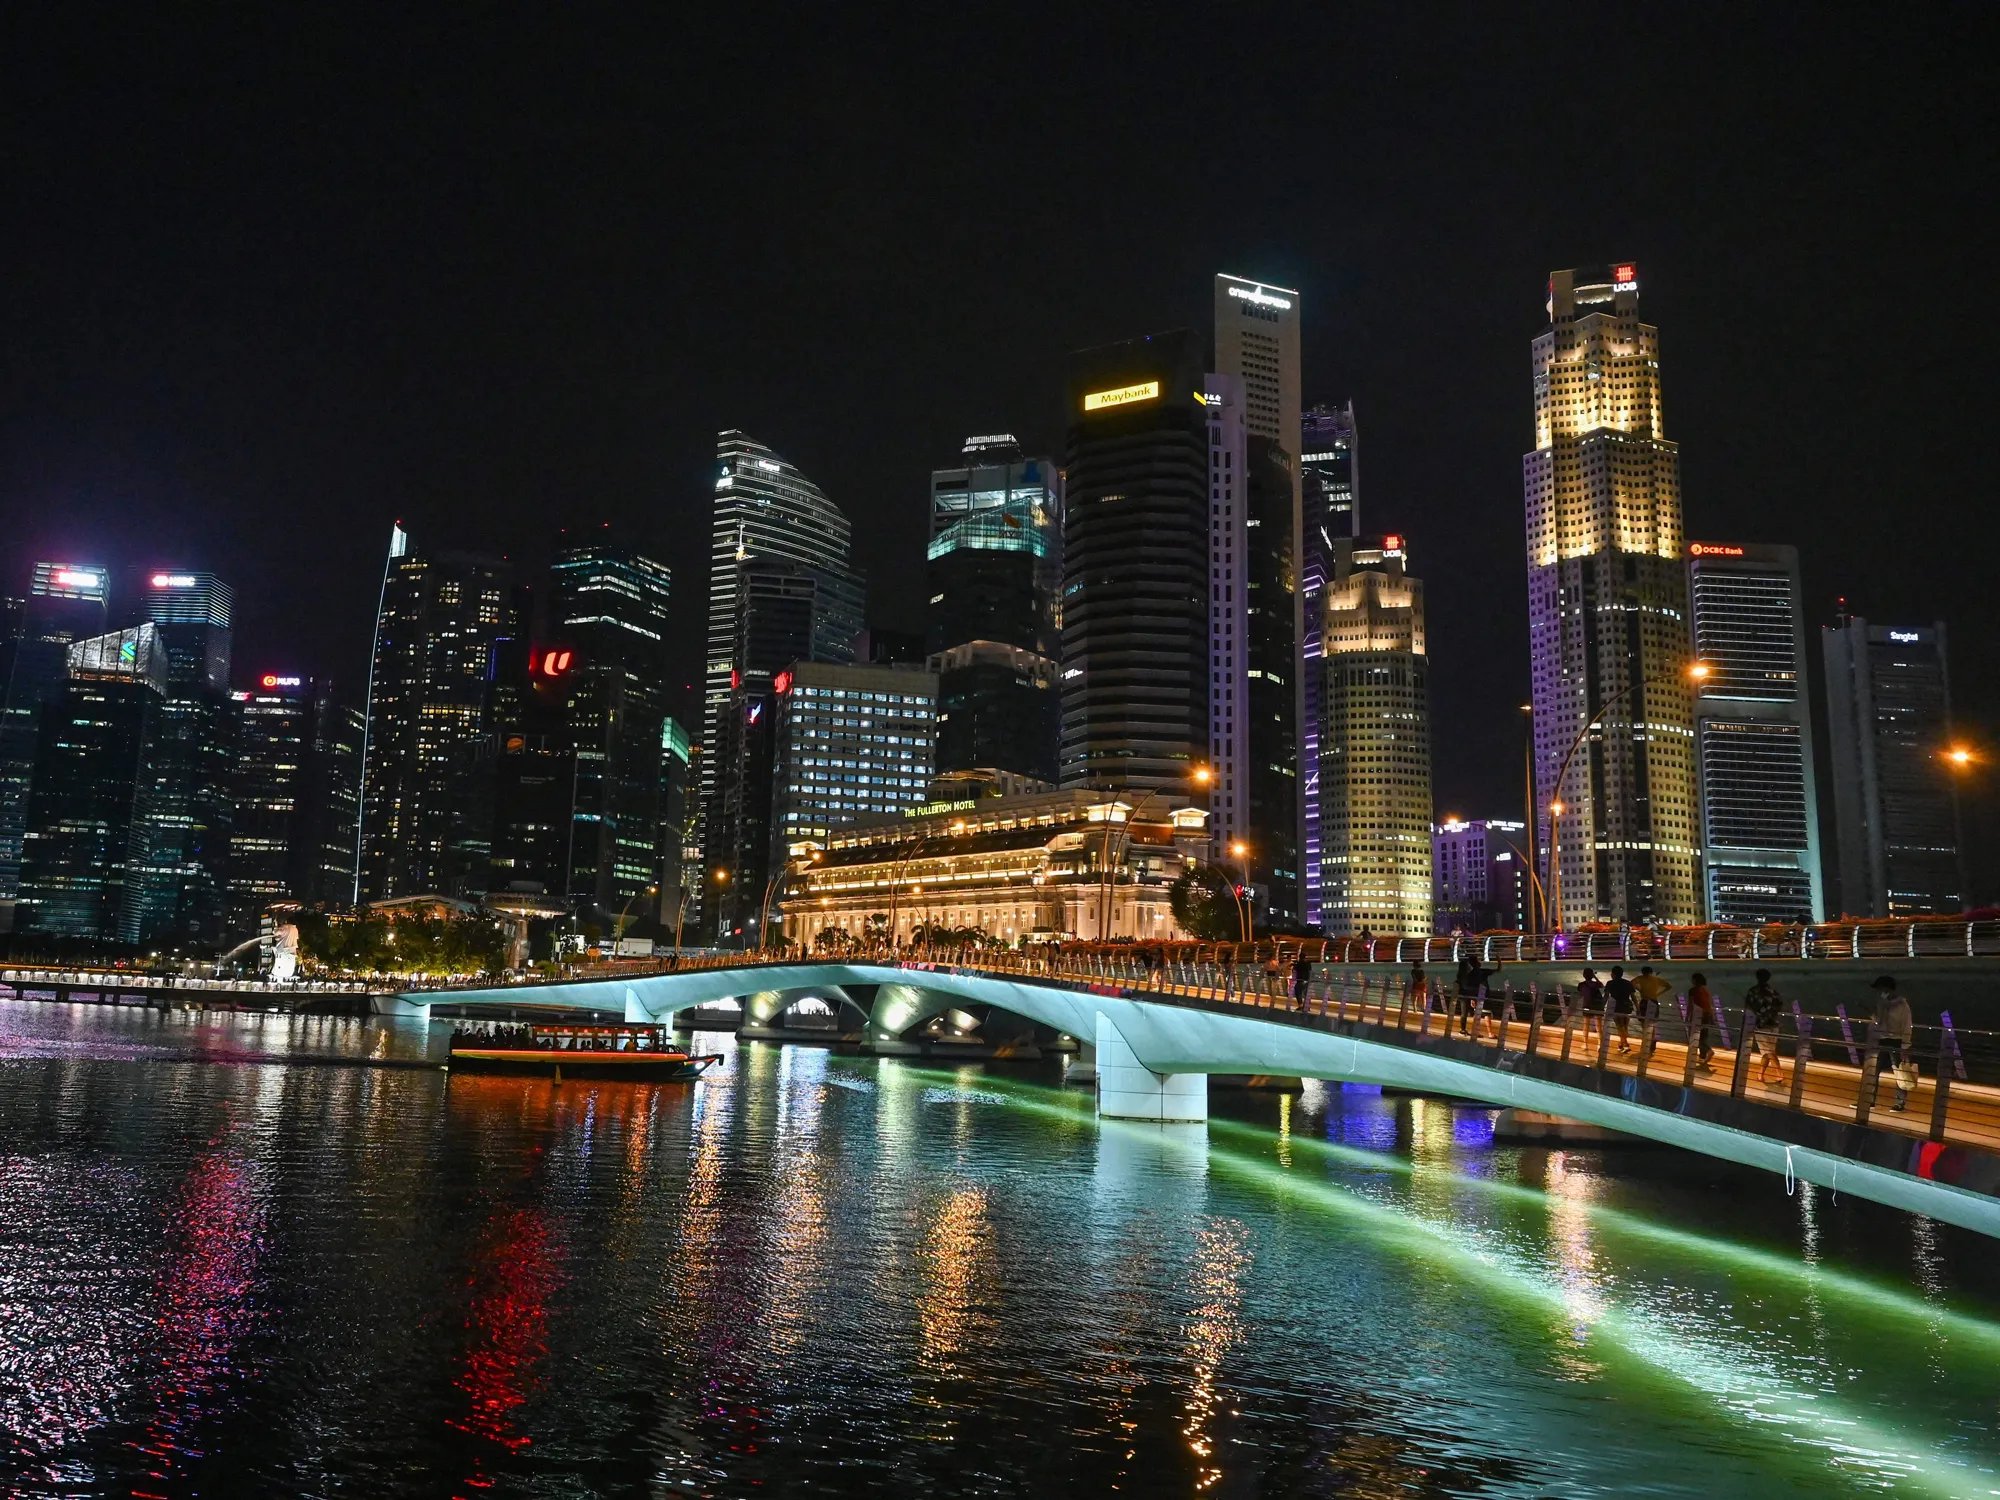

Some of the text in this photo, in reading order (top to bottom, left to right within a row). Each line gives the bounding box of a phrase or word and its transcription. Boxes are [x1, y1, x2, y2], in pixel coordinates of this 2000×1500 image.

[1613, 281, 1638, 293] UOB
[1101, 386, 1152, 403] Maybank
[1702, 546, 1743, 555] OCBC Bank
[904, 800, 976, 818] THE FULLERTON HOTEL
